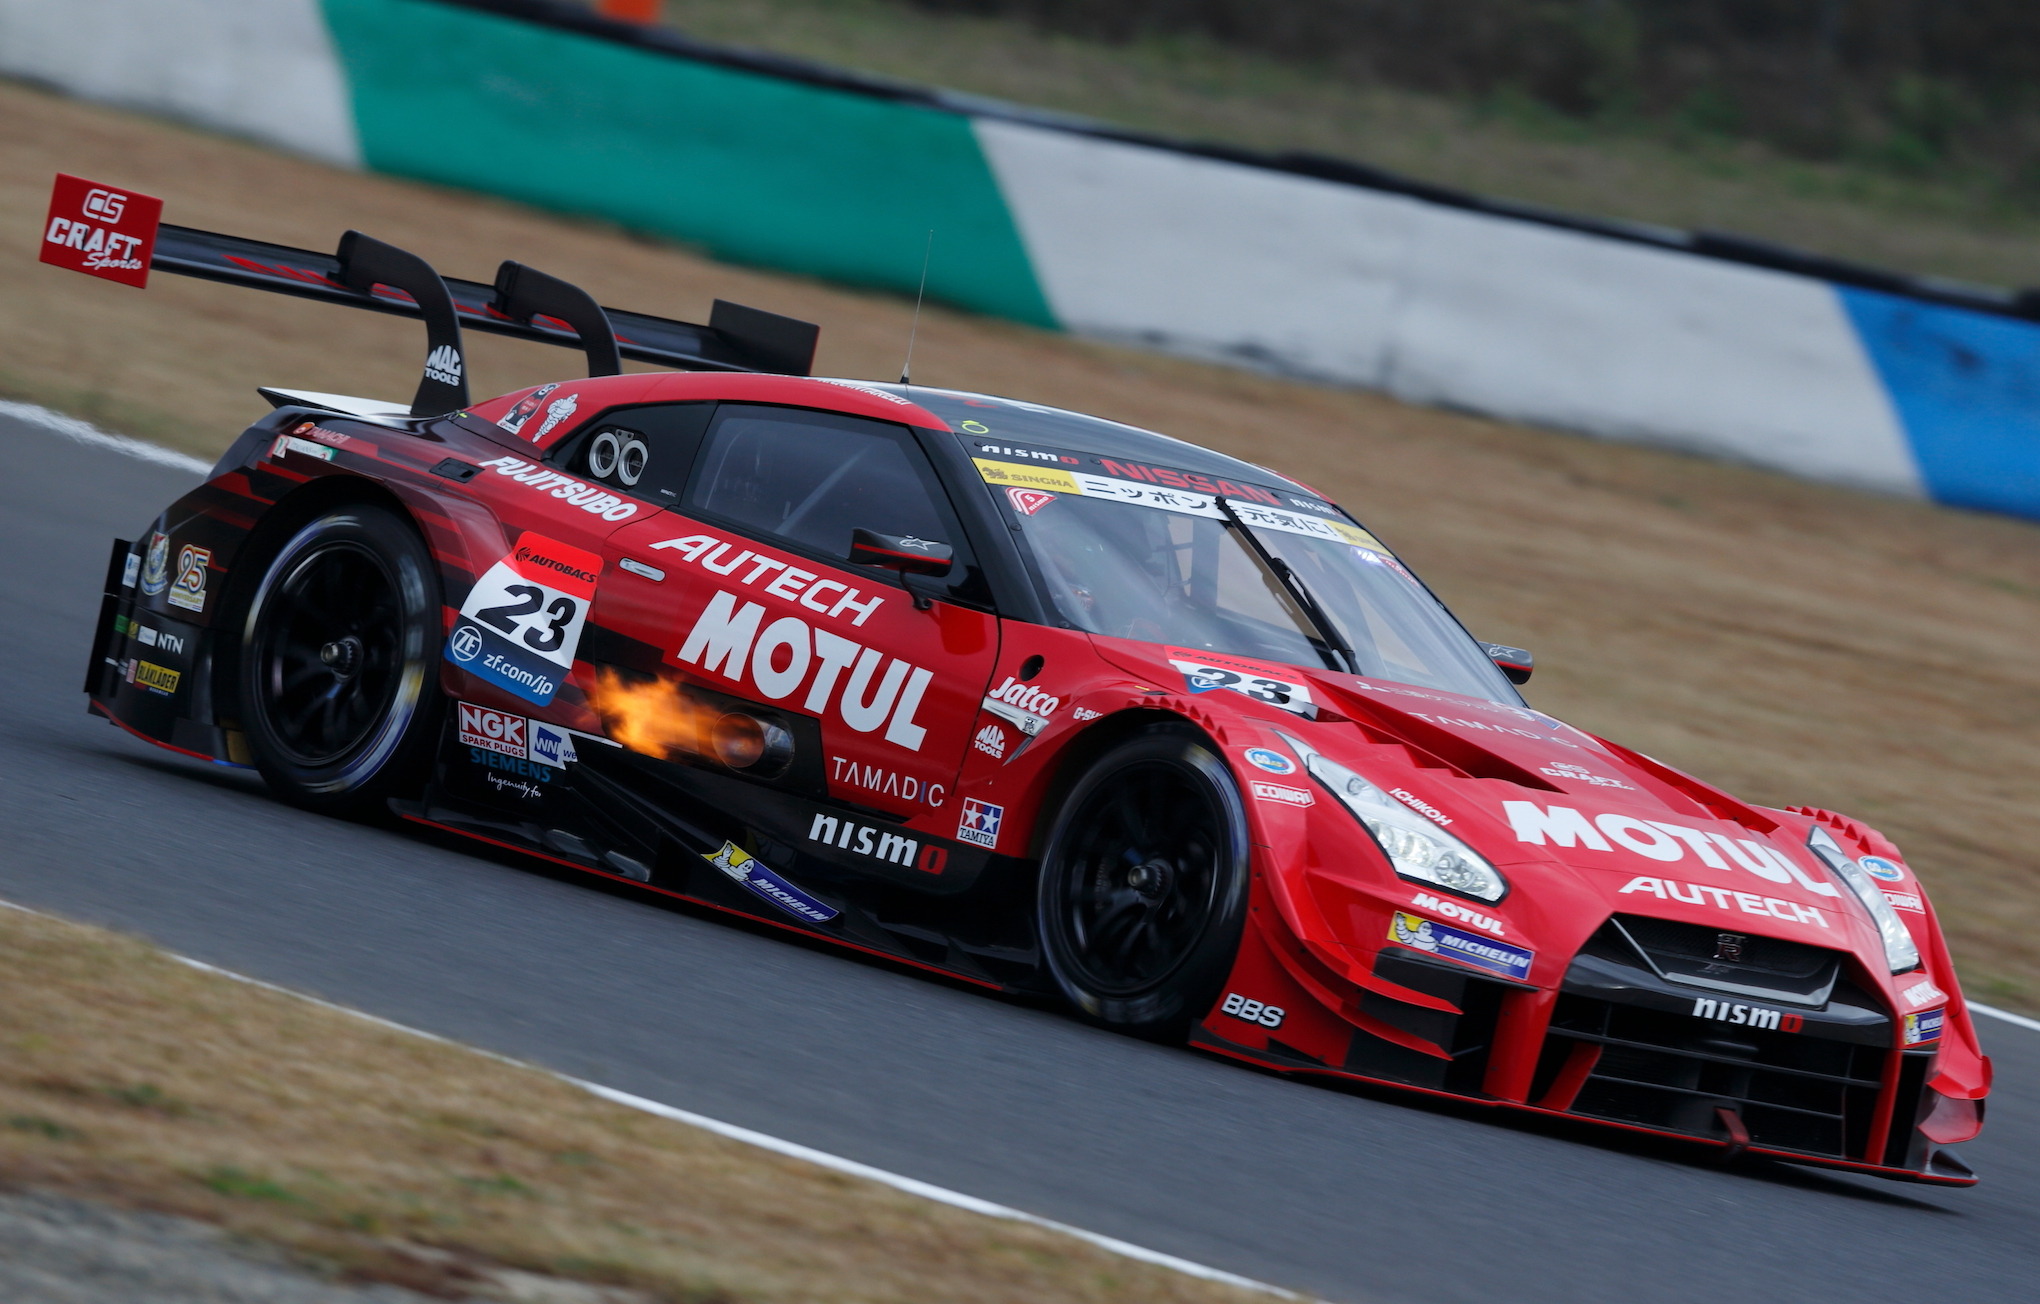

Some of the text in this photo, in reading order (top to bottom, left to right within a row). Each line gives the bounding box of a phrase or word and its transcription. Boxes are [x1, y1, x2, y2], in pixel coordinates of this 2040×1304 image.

[46, 216, 142, 260] CRAFT
[82, 251, 143, 271] Sports
[425, 366, 460, 387] TOOLS
[426, 344, 462, 377] MAC
[982, 444, 1079, 465] nismo
[478, 455, 638, 521] FUJITSUBO
[1011, 474, 1073, 488] SINGHA
[1100, 459, 1283, 506] NISSAN
[1085, 480, 1338, 537] ニッポン元気に!
[172, 544, 211, 595] 25
[529, 554, 597, 583] AUTOBACS
[648, 534, 885, 627] AUTECH
[474, 584, 577, 652] 23
[157, 633, 184, 655] NTN
[454, 629, 481, 659] ZF
[483, 654, 554, 695] zf.com/jp
[676, 589, 934, 752] MOTUL
[1196, 656, 1298, 679] AUTOBACS
[989, 676, 1059, 717] Jatco
[1197, 668, 1292, 704] 23
[461, 706, 524, 746] NGK
[976, 725, 1005, 751] MAC
[462, 734, 525, 757] SPARK PLUGS
[974, 740, 1002, 759] TOOLS
[470, 748, 551, 783] SIEMENS
[832, 756, 945, 808] TAMADIC
[487, 772, 531, 798] Ingenuity
[1389, 787, 1453, 826] ICHIKOH
[808, 812, 948, 875] nismo
[959, 827, 995, 847] TAMIYA
[1502, 800, 1842, 898] MOTUL
[753, 878, 829, 920] MICHELIN
[1411, 893, 1505, 936] MOTUL
[1618, 876, 1829, 928] AUTECH
[1440, 934, 1530, 969] MICHELIN
[1221, 993, 1285, 1028] BBS
[1692, 997, 1803, 1033] nismo
